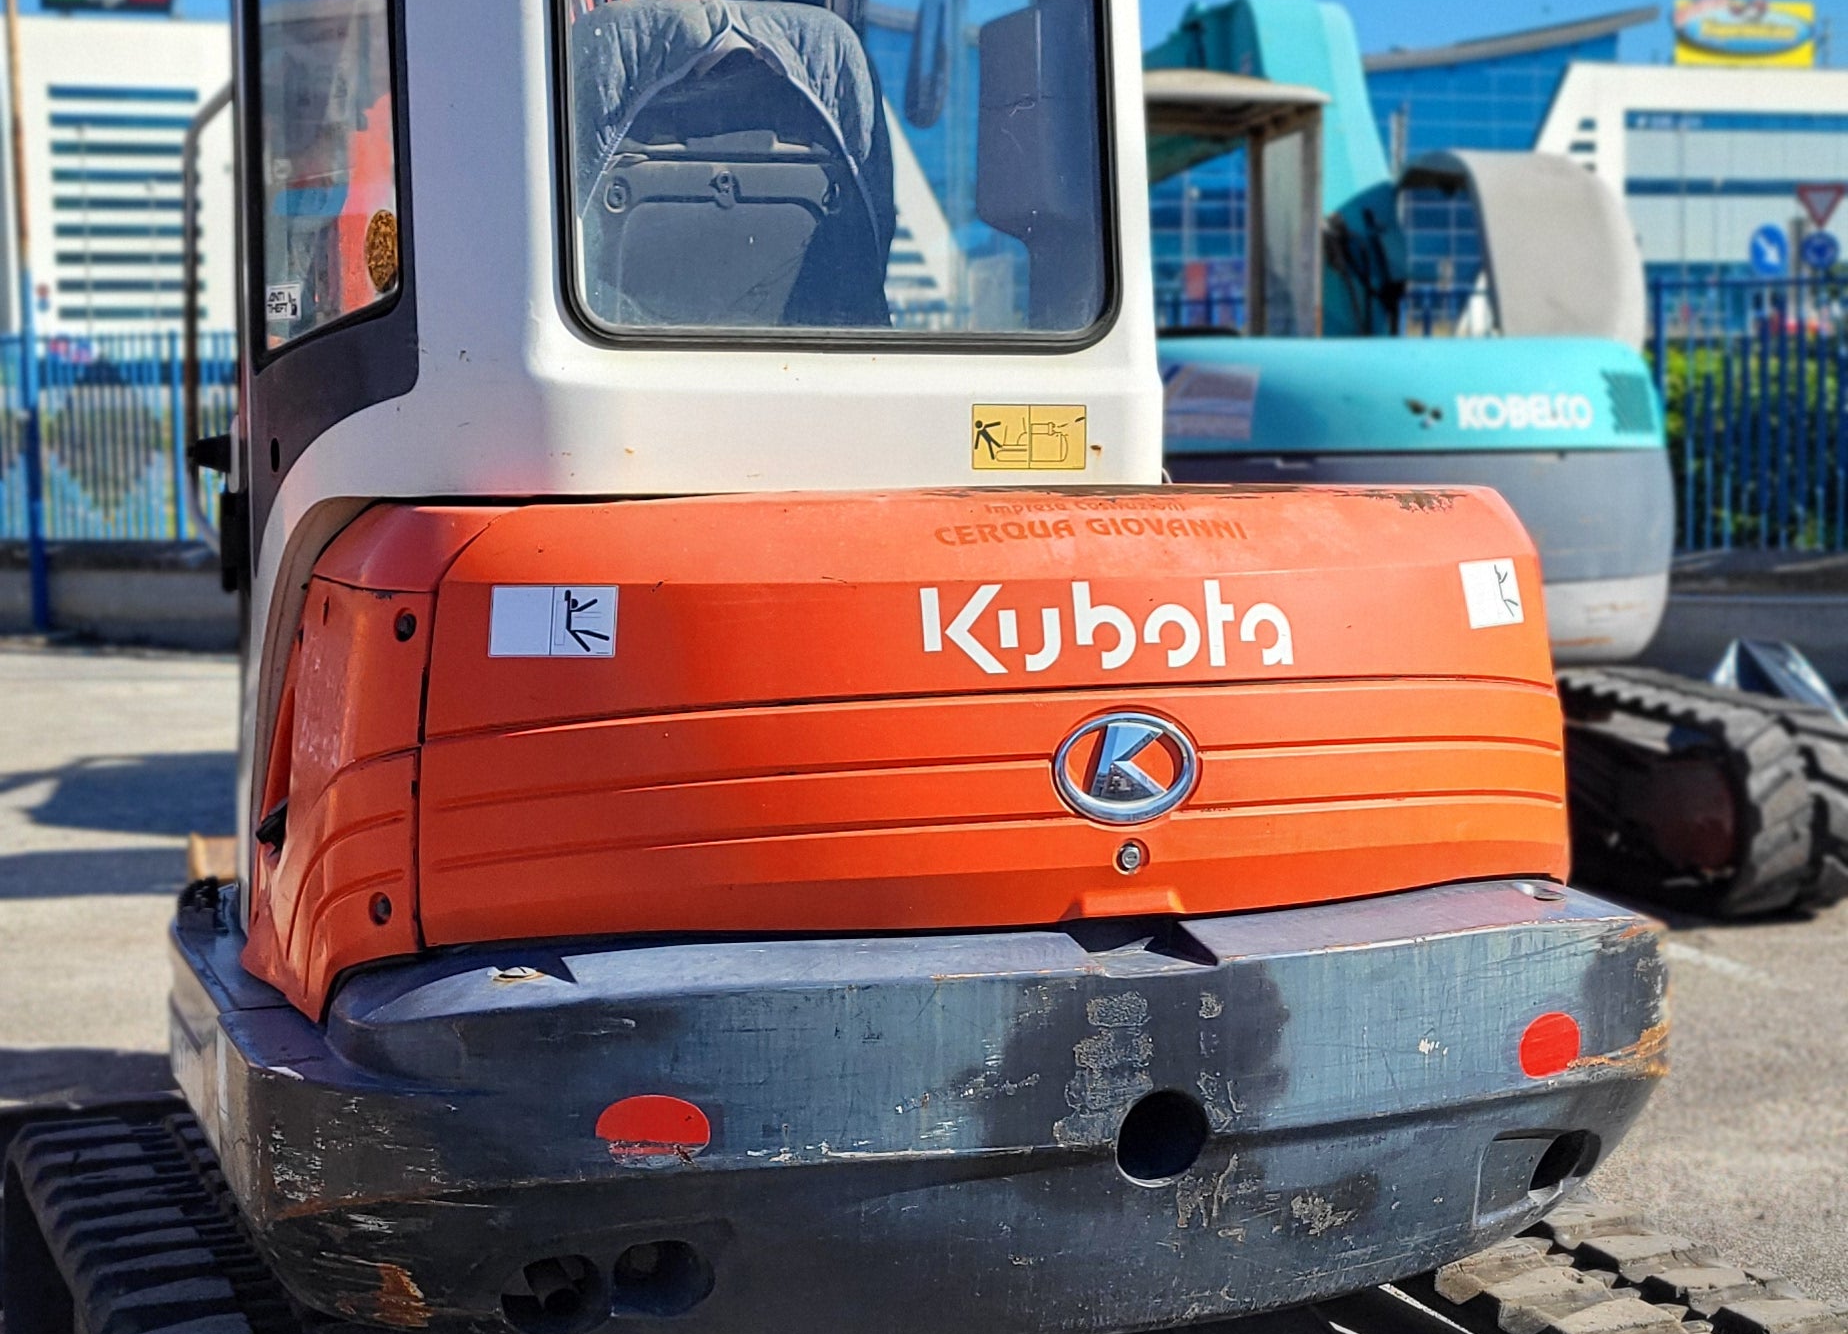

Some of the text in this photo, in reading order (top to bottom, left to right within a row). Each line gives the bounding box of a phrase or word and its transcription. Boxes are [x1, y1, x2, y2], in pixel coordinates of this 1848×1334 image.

[268, 291, 285, 302] ANTI
[267, 303, 288, 314] THEFT
[1457, 393, 1593, 430] KOBELCO
[984, 502, 1067, 516] Impresa
[934, 517, 1248, 547] CERQUA GIOVANNI
[919, 579, 1295, 675] Kubota
